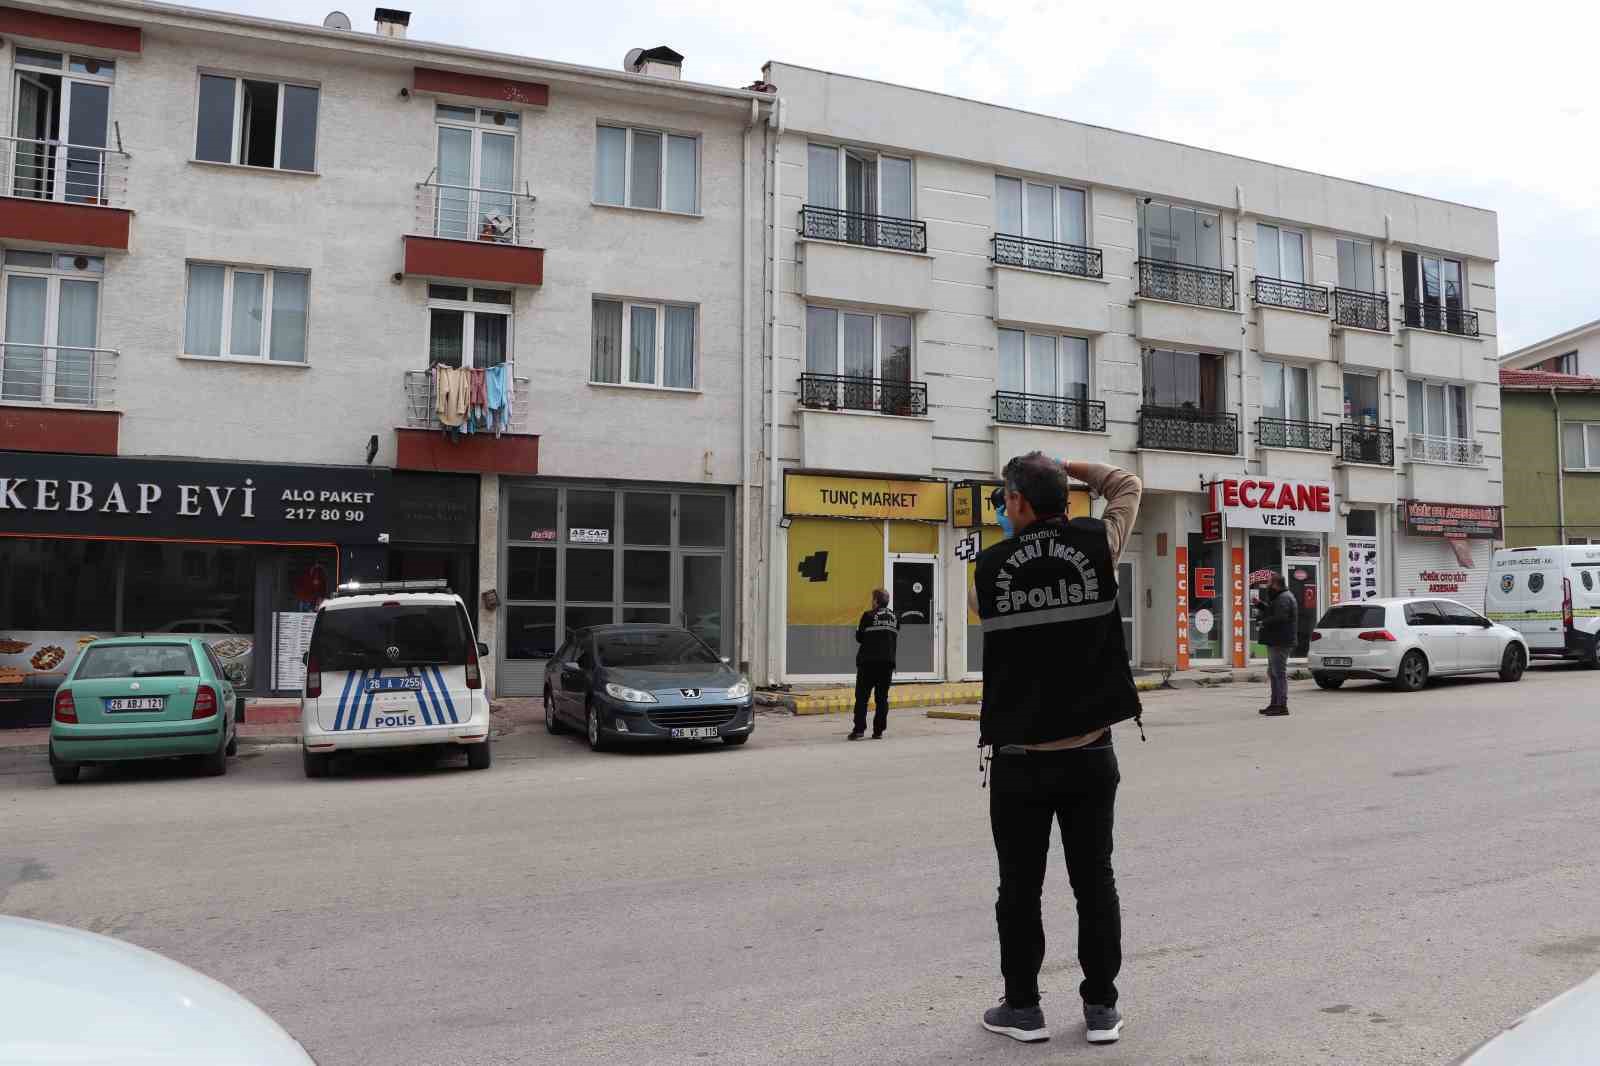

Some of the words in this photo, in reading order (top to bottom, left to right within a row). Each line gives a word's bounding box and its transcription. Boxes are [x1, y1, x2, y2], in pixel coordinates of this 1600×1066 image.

[0, 478, 163, 515] KEBAP
[176, 478, 257, 518] EVİ
[282, 489, 315, 502] ALO
[320, 491, 375, 504] PAKET
[819, 488, 860, 510] TUNÇ
[862, 489, 918, 508] MARKET
[1223, 479, 1331, 513] ECZANE
[285, 508, 318, 520] 217
[320, 508, 341, 522] 80
[344, 509, 364, 522] 90
[1262, 513, 1296, 527] VEZİR
[1203, 517, 1220, 540] E
[995, 567, 1013, 613] OLAY
[1006, 539, 1042, 568] YERİ
[1048, 538, 1099, 600] İNCELEME
[1195, 567, 1216, 599] E
[1011, 579, 1084, 611] POLİS
[1178, 564, 1188, 655] ECZANE
[1234, 564, 1244, 653] ECZANE
[369, 680, 380, 689] 26
[387, 679, 392, 688] A
[400, 678, 420, 688] 7255
[111, 700, 122, 709] 26
[375, 713, 416, 728] POLİS
[705, 727, 717, 737] 115
